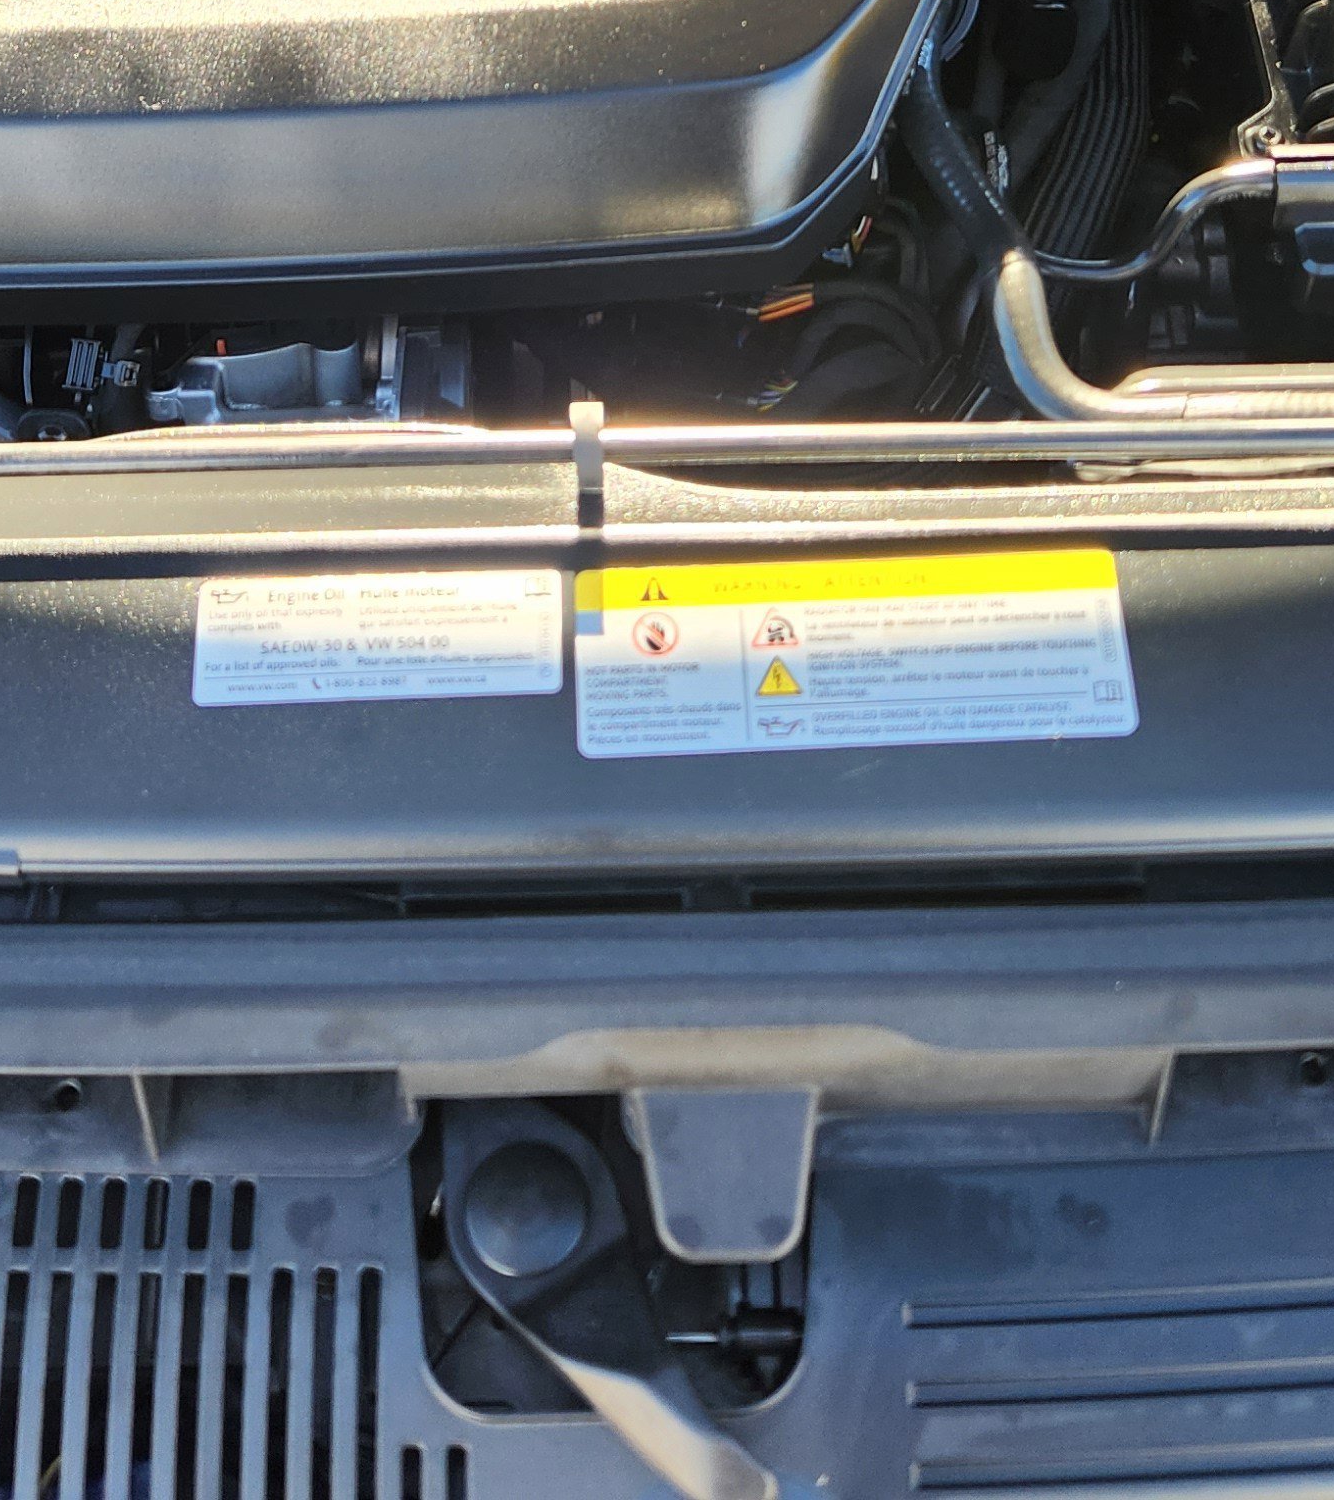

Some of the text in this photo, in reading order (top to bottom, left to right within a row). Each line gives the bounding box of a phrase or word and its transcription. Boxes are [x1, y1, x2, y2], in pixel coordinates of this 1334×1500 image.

[268, 589, 318, 605] Engine
[324, 588, 344, 599] Oil
[346, 638, 356, 650] &
[366, 636, 392, 649] VW
[398, 635, 425, 648] 504
[429, 634, 449, 647] 00
[205, 662, 221, 671] For
[234, 661, 249, 670] list
[253, 660, 263, 669] of
[266, 658, 316, 670] approved
